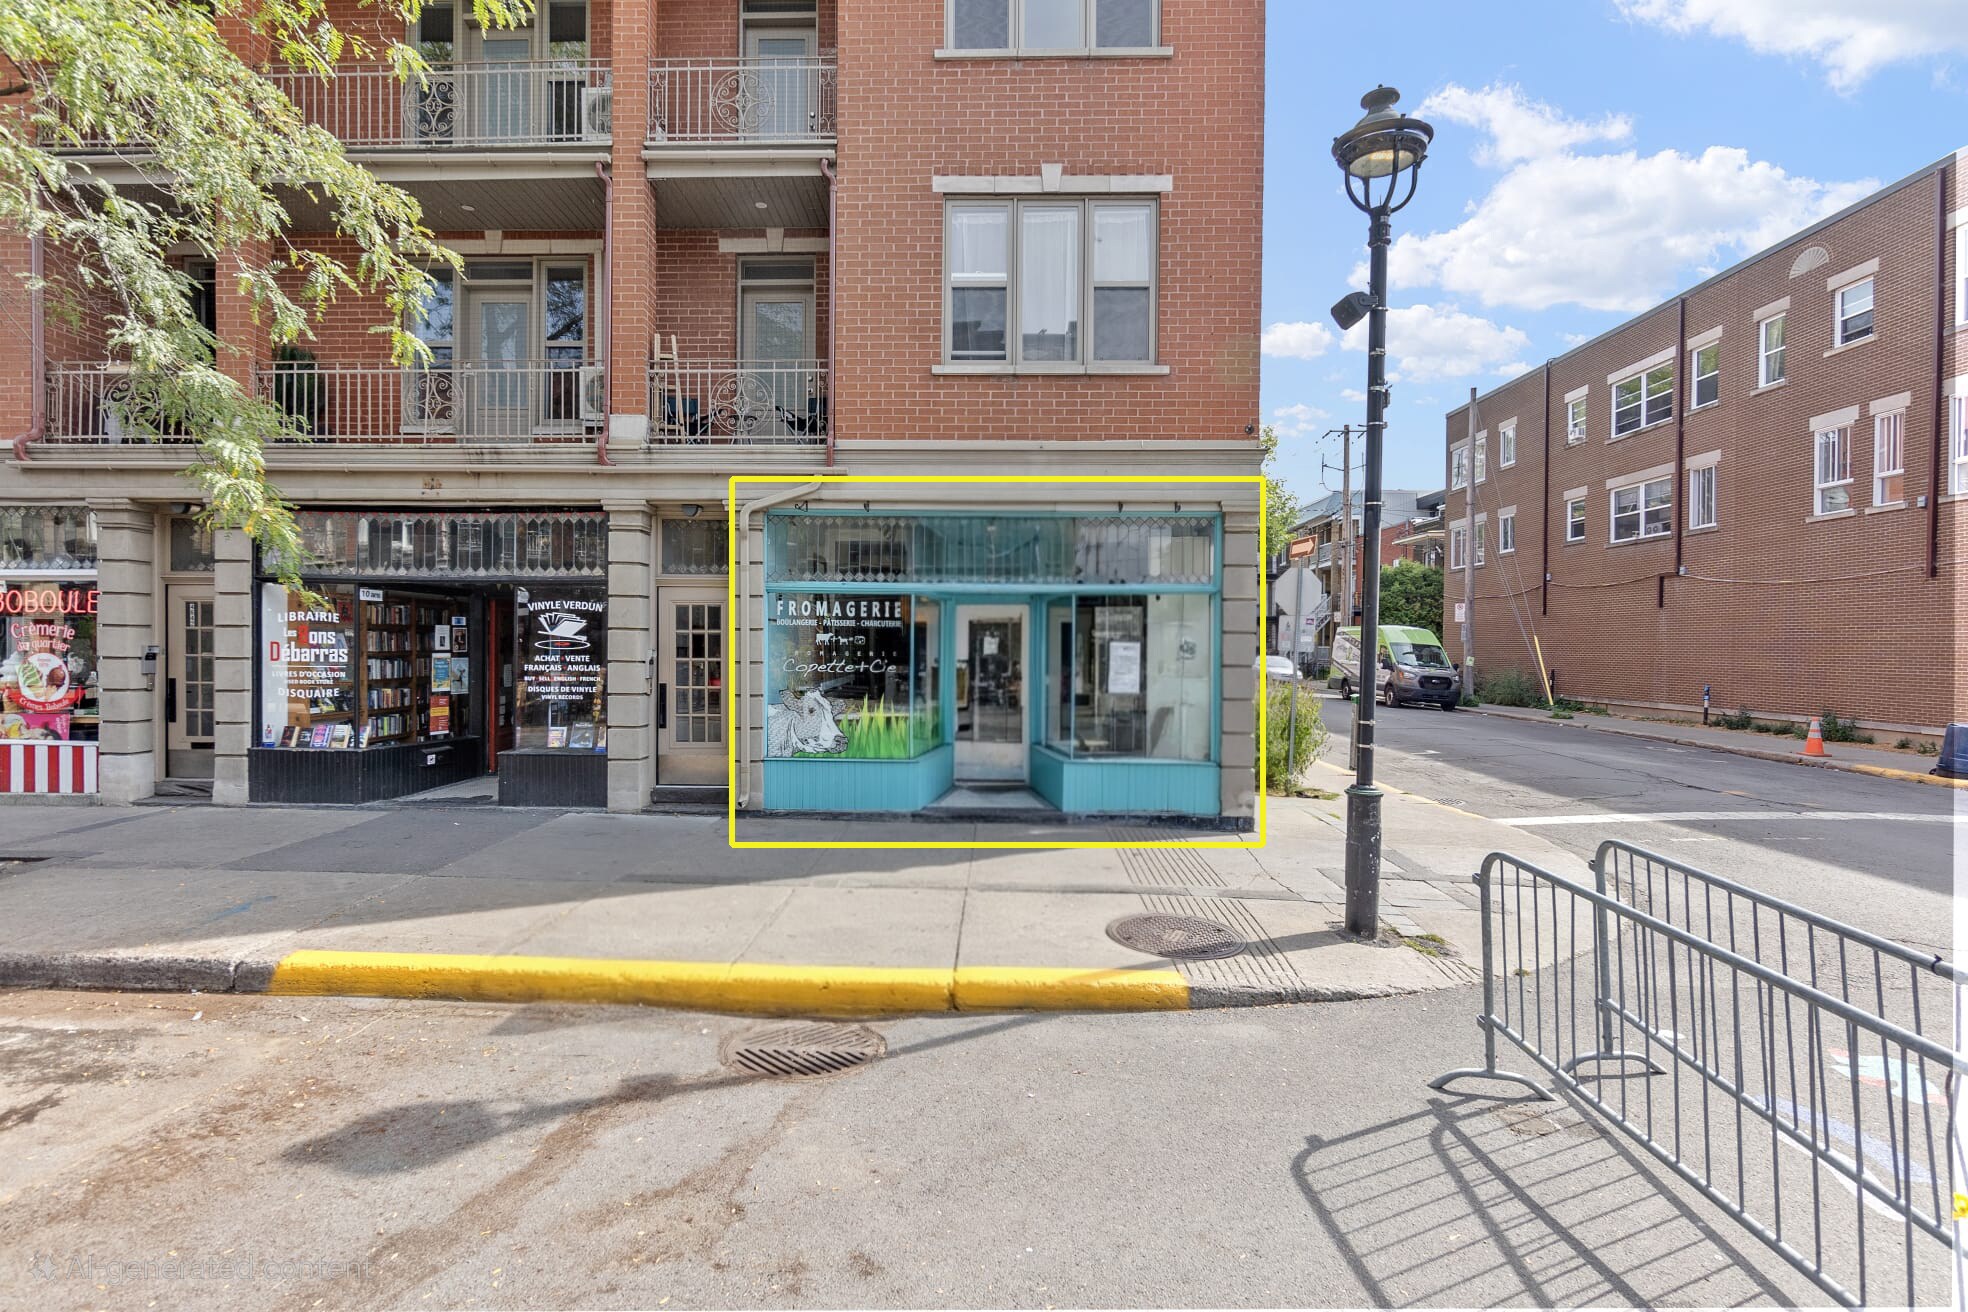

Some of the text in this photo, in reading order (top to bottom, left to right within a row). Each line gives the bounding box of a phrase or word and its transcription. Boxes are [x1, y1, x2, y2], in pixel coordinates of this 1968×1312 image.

[527, 600, 604, 612] VINYLE VERDUN
[776, 600, 902, 618] FROMAGERIE
[277, 611, 340, 623] LIBRAIRIE
[776, 618, 818, 626] BOULANGERIE
[860, 619, 902, 628] CHARCUTERIE
[11, 622, 75, 640] Crèmerie
[297, 624, 336, 645] Bons
[32, 639, 71, 652] quartier
[269, 640, 349, 662] Débarras
[524, 664, 562, 672] FRANÇAIS
[278, 687, 340, 699] DISQUAIRE
